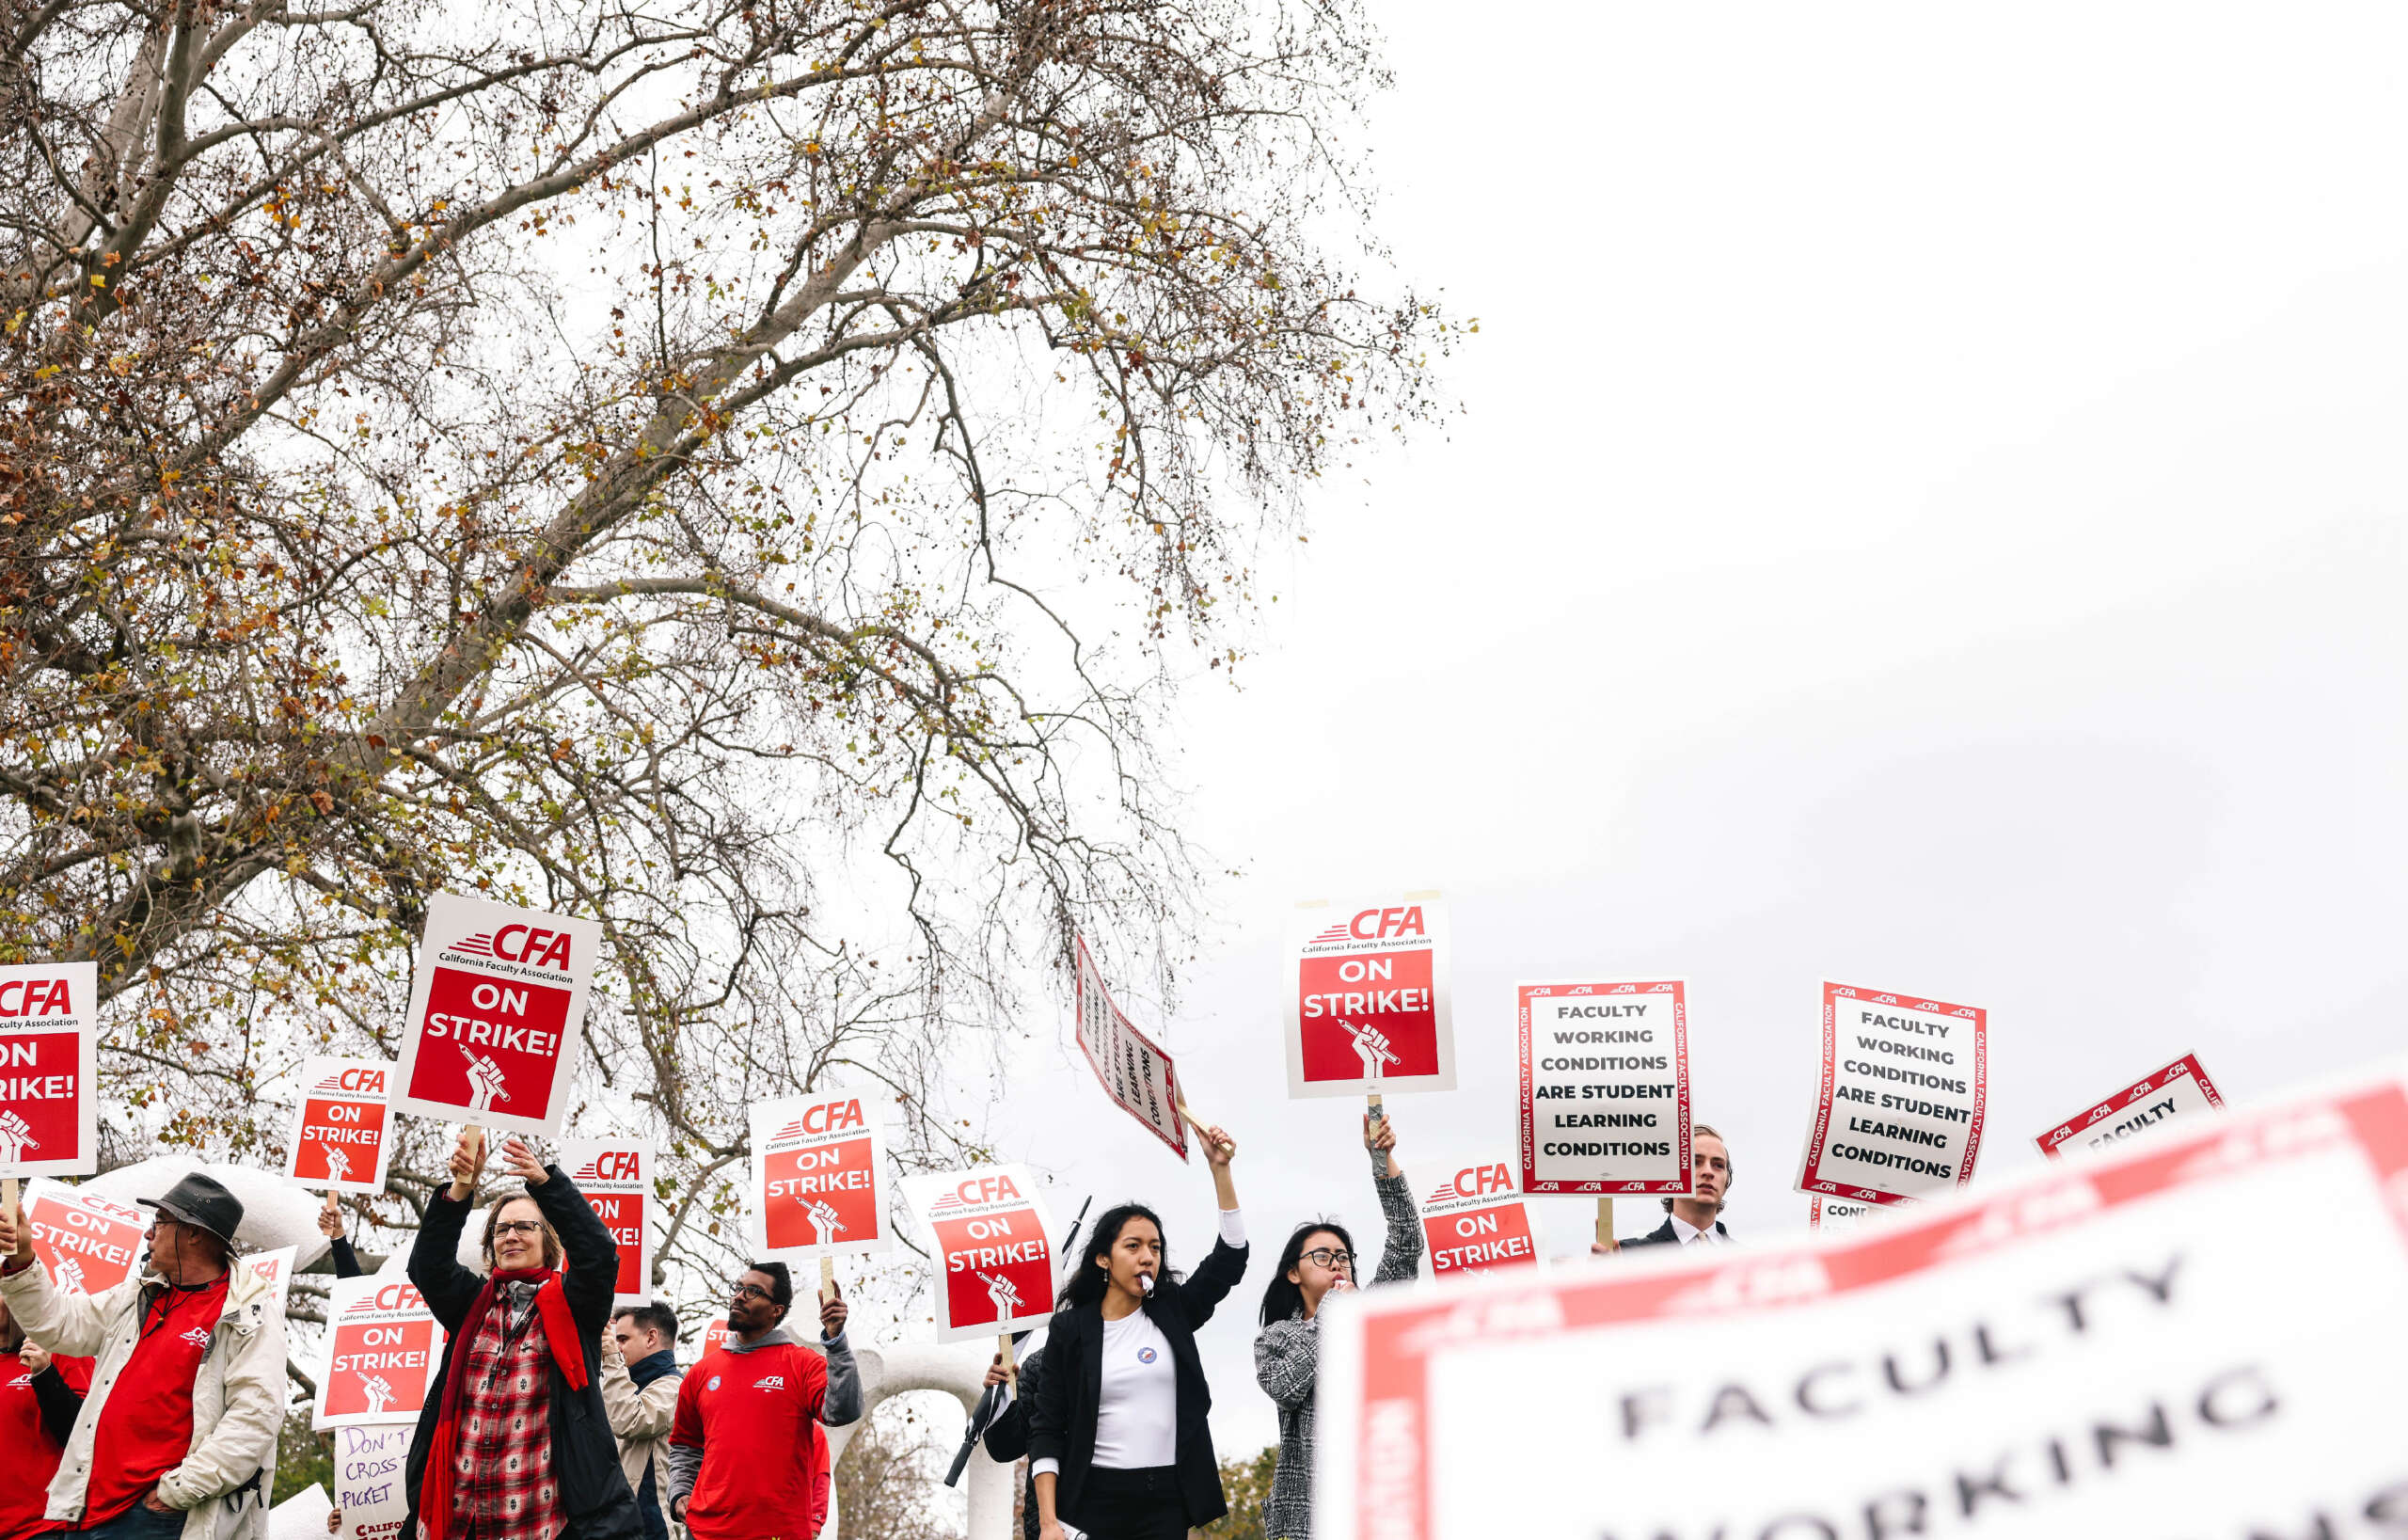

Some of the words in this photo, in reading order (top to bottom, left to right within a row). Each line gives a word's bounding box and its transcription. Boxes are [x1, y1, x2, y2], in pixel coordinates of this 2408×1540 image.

[1350, 906, 1425, 940] CFA
[493, 924, 571, 971] CFA
[1302, 945, 1344, 953] California
[1347, 942, 1378, 950] Faculty
[1381, 938, 1432, 946] Association
[439, 952, 483, 968] California
[485, 961, 519, 975] Faculty
[520, 967, 573, 984] Association
[1339, 959, 1392, 982] ON
[0, 979, 71, 1017] CFA
[471, 983, 529, 1016] ON
[1534, 988, 1551, 996] CFA
[1618, 985, 1636, 993] CFA
[1656, 984, 1674, 992] CFA
[1839, 988, 1856, 997] CFA
[1879, 993, 1897, 1005] CFA
[1304, 988, 1429, 1018] STRIKE!
[1558, 1005, 1647, 1019] FACULTY
[1922, 1001, 1940, 1012] CFA
[1958, 1008, 1975, 1018] CFA
[0, 1021, 23, 1029] culty
[25, 1019, 78, 1027] Association
[427, 1012, 557, 1057] STRIKE!
[1675, 1002, 1686, 1056] CALIFORNIA
[1824, 1004, 1832, 1062] ASSOCIATION
[1861, 1011, 1949, 1039] FACULTY
[1520, 1007, 1529, 1067] ASSOCIATION
[1554, 1030, 1653, 1044] WORKING
[1857, 1036, 1954, 1065] WORKING
[1976, 1031, 1986, 1084] CALIFORNIA
[1125, 1040, 1142, 1106] LEARNING
[1541, 1056, 1668, 1071] CONDITIONS
[2169, 1062, 2188, 1077] CFA
[0, 1075, 74, 1101] IKE!
[340, 1069, 385, 1092] CFA
[1140, 1047, 1161, 1126] CONDITIONS
[1677, 1059, 1687, 1103] FACULTY
[1821, 1063, 1831, 1107] FACULTY
[1844, 1059, 1966, 1094] CONDITIONS
[1535, 1086, 1576, 1099] ARE
[1582, 1085, 1674, 1099] STUDENT
[2133, 1082, 2153, 1097] CFA
[327, 1105, 360, 1122] ON
[1836, 1086, 1876, 1105] ARE
[1880, 1093, 1971, 1124] STUDENT
[1975, 1085, 1986, 1131] FACULTY
[2093, 1103, 2113, 1119] CFA
[802, 1099, 863, 1135] CFA
[1555, 1114, 1656, 1128] LEARNING
[303, 1125, 378, 1145] STRIKE!
[766, 1139, 800, 1151] California
[801, 1135, 827, 1144] Faculty
[829, 1128, 870, 1139] Association
[1524, 1112, 1532, 1170] CALIFORNIA
[1679, 1103, 1688, 1170] ASSOCIATION
[1809, 1108, 1828, 1167] CALIFORNIA
[1849, 1117, 1947, 1149] LEARNING
[2053, 1126, 2072, 1141] CFA
[797, 1148, 840, 1170] ON
[1544, 1142, 1670, 1156] CONDITIONS
[596, 1151, 640, 1180] CFA
[1831, 1143, 1951, 1180] CONDITIONS
[768, 1170, 870, 1197] STRIKE!
[958, 1175, 1022, 1205] CFA
[1454, 1163, 1513, 1198] CFA
[1541, 1182, 1560, 1191] CFA
[1583, 1182, 1602, 1191] CFA
[1626, 1182, 1645, 1191] CFA
[1665, 1182, 1684, 1191] CFA
[1819, 1182, 1836, 1193] CFA
[1422, 1203, 1455, 1214] California
[1456, 1199, 1481, 1208] Faculty
[1860, 1190, 1877, 1200] CFA
[82, 1197, 140, 1221] CFA
[66, 1212, 110, 1234] ON
[967, 1218, 1012, 1239] ON
[1456, 1214, 1497, 1237] ON
[31, 1222, 131, 1266] STRIKE!
[948, 1239, 1046, 1272] STRIKE!
[1434, 1236, 1530, 1269] STRIKE!
[340, 1313, 370, 1322] California
[363, 1327, 404, 1346] ON
[1618, 1251, 2187, 1441] FACULTY
[334, 1351, 426, 1372] STRIKE!
[766, 1376, 784, 1386] CFA
[343, 1427, 410, 1458] DON'T
[1599, 1364, 2281, 1540] RKING
[346, 1458, 397, 1480] CROSS
[341, 1483, 392, 1510] PICKET
[356, 1520, 403, 1536] CALIFO
